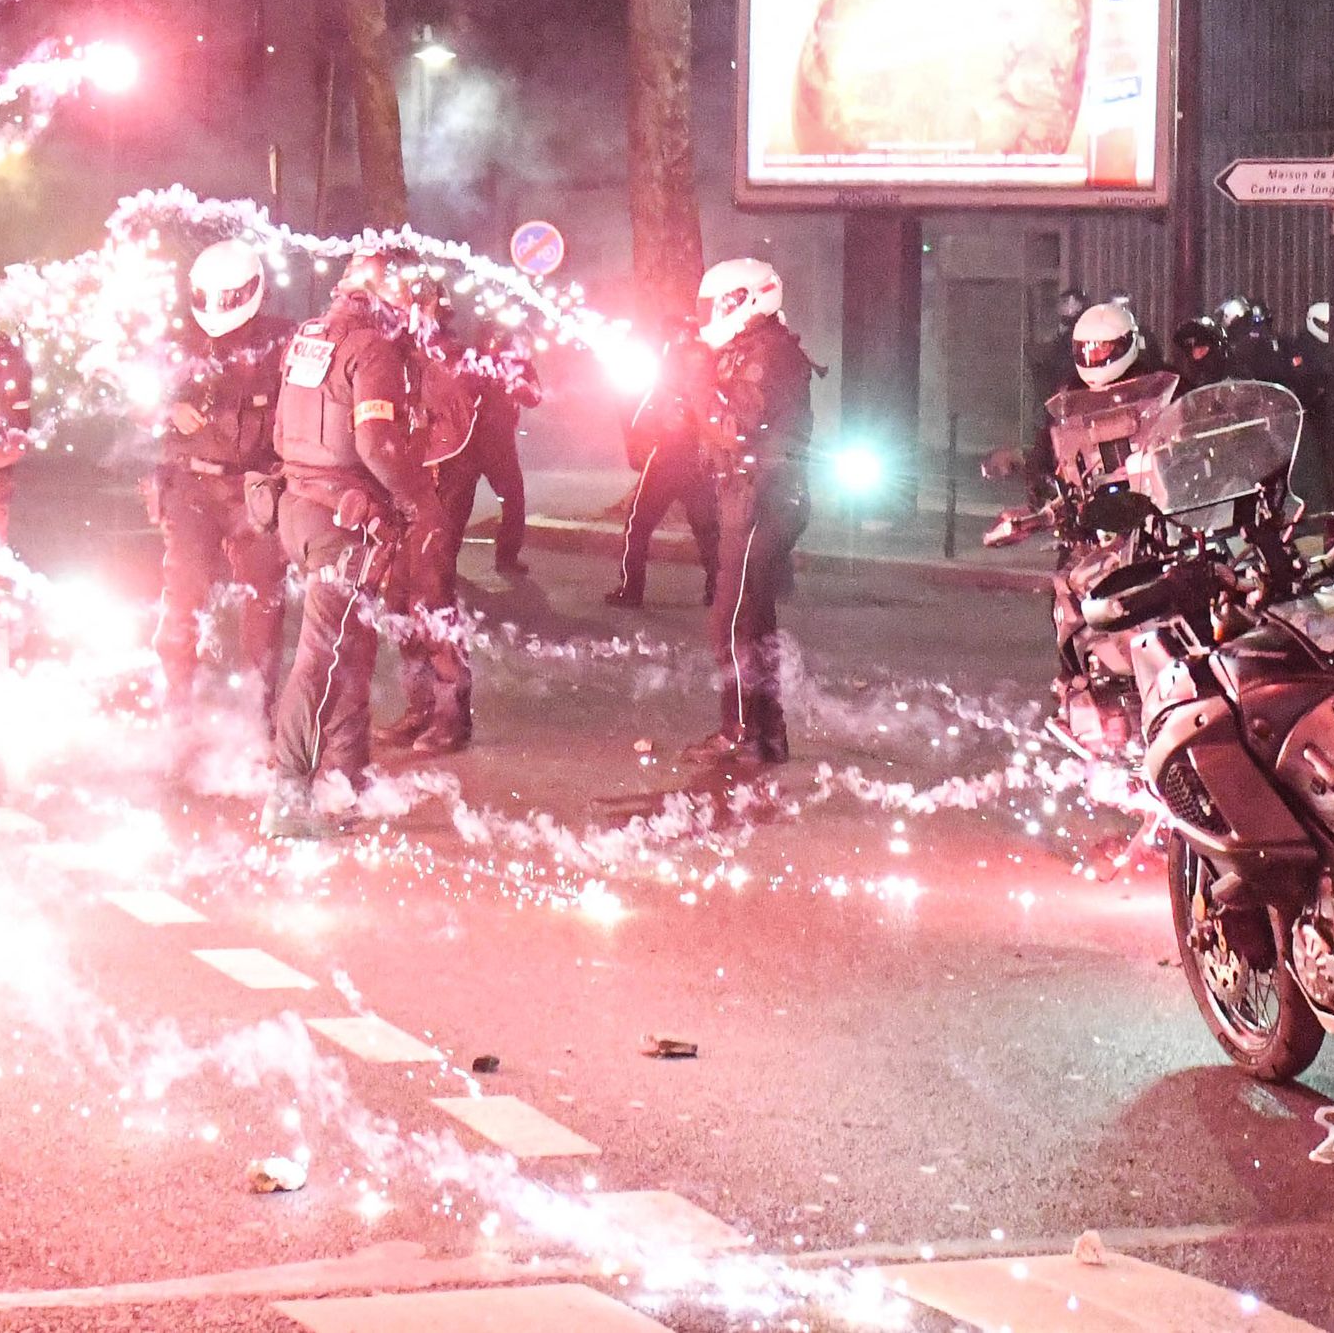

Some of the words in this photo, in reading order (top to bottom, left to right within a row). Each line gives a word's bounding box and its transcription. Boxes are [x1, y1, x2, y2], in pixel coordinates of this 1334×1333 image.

[1268, 169, 1308, 179] Maison
[1313, 168, 1326, 179] de
[1250, 184, 1288, 194] Centre
[1292, 184, 1306, 194] de
